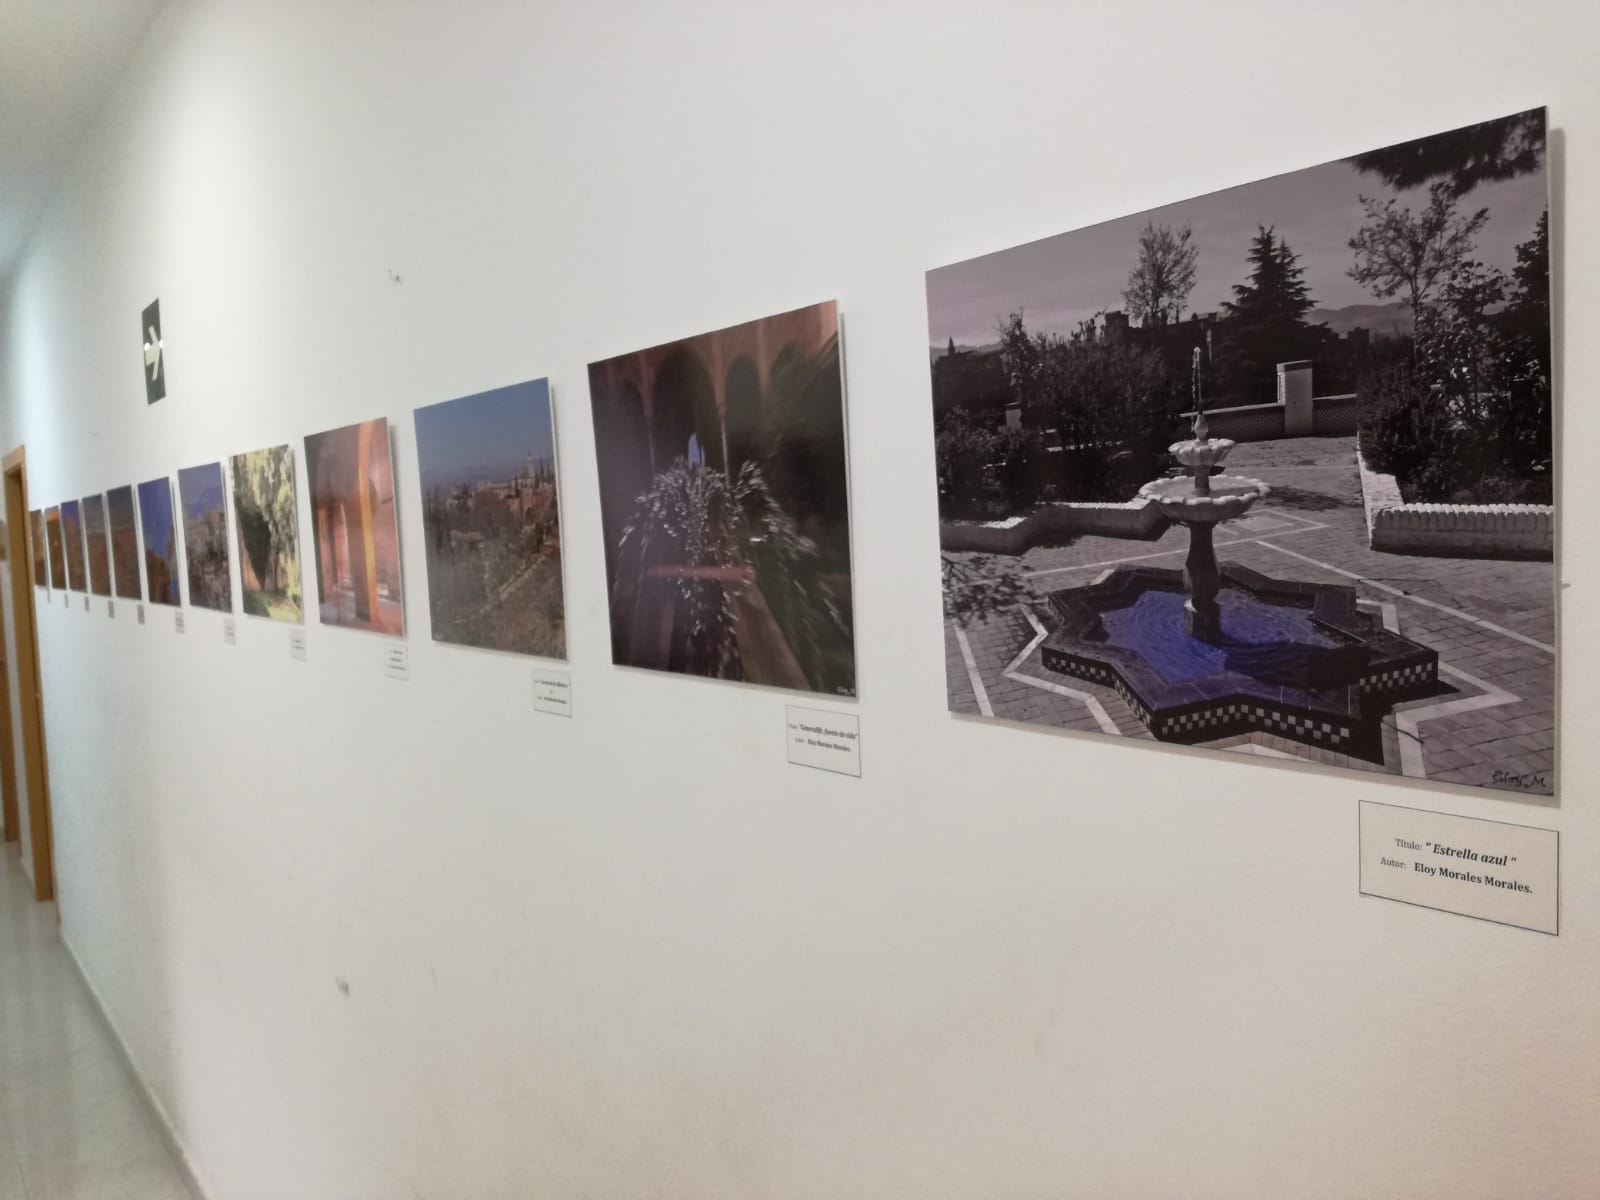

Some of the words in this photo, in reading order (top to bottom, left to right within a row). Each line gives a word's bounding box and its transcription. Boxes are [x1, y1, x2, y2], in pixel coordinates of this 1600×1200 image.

[1432, 843, 1478, 861] Estrella
[1481, 854, 1508, 866] azul
[1414, 862, 1437, 876] Eloy
[1439, 867, 1482, 884] Morales
[1484, 875, 1533, 894] Morales.
